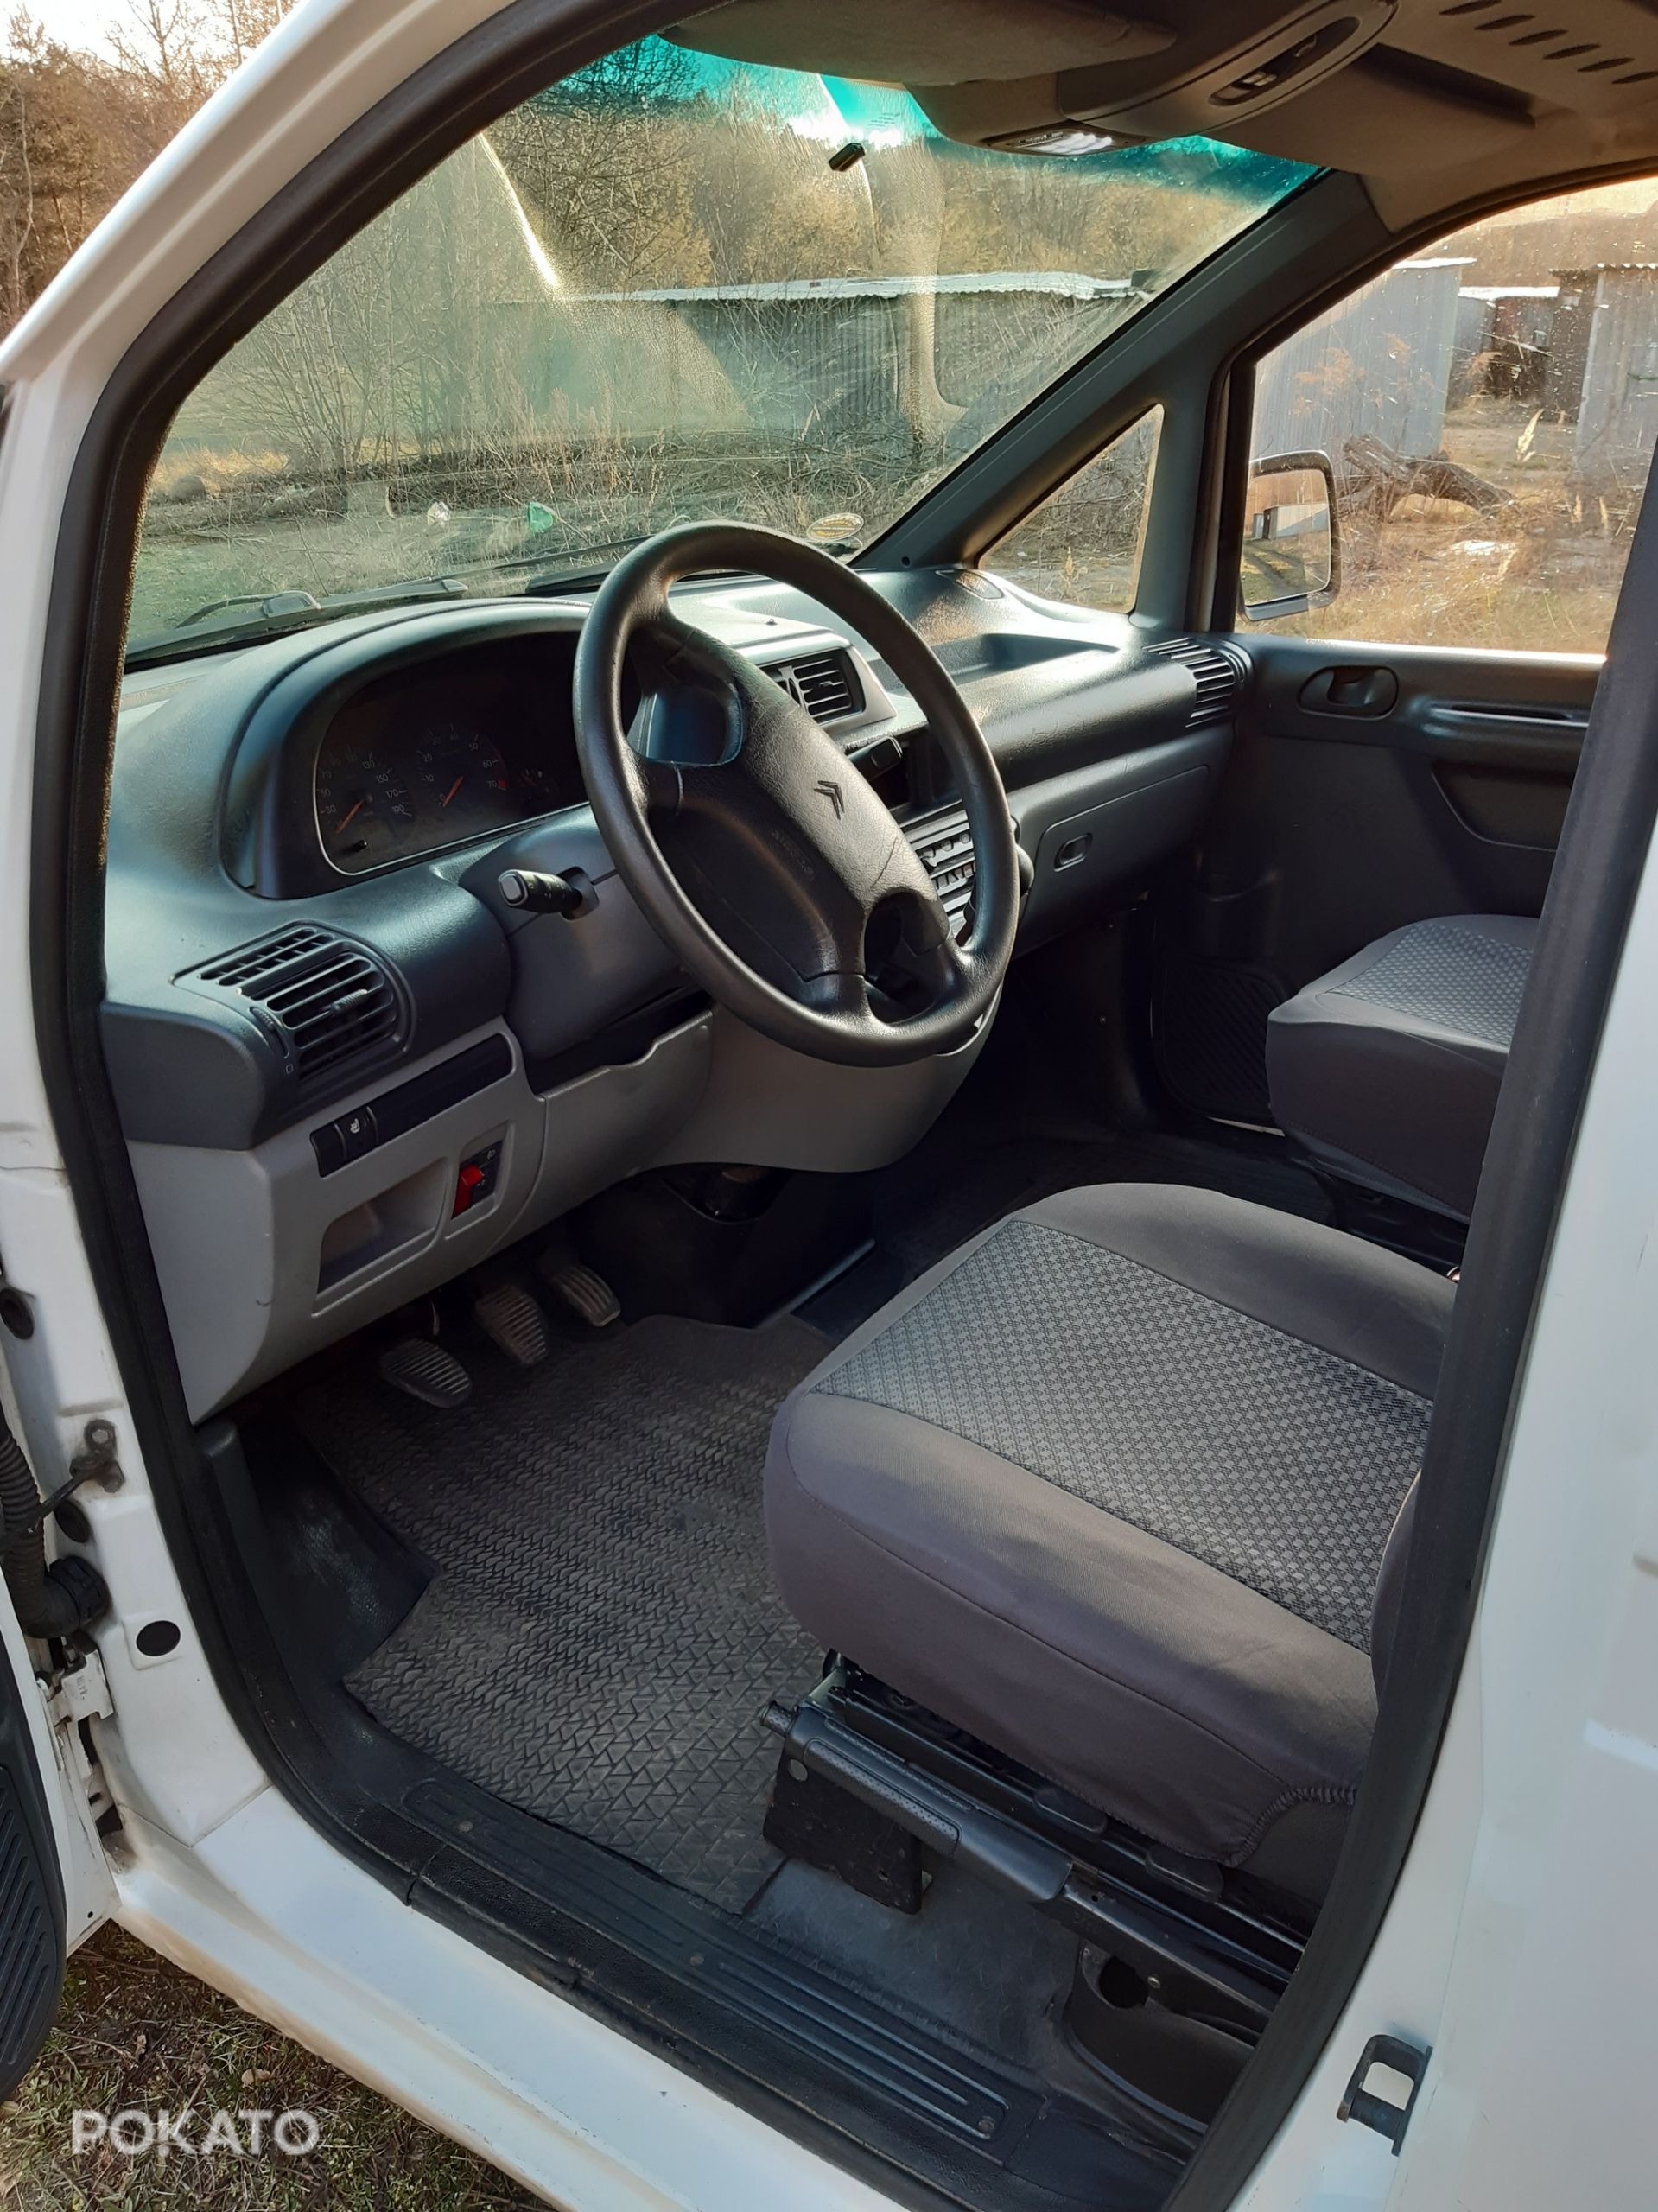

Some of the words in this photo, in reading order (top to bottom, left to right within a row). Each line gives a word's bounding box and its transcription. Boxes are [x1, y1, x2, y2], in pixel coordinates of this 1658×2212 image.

[482, 760, 492, 768] 60
[376, 773, 389, 784] 150
[486, 779, 498, 788] 70
[385, 789, 399, 798] 170
[324, 804, 336, 815] 30
